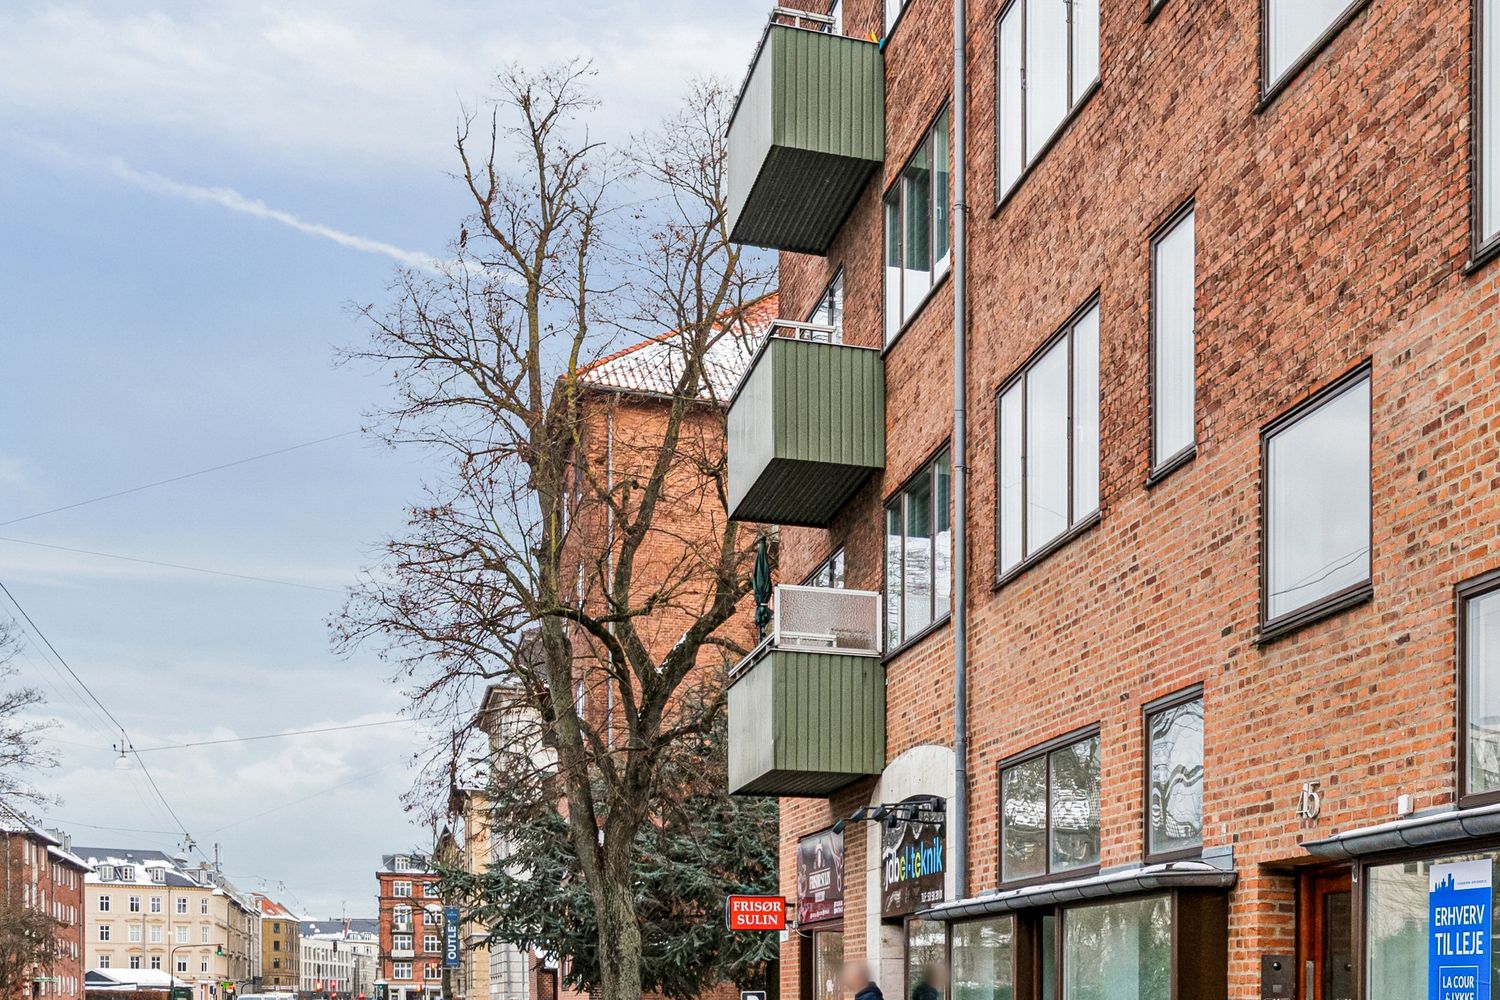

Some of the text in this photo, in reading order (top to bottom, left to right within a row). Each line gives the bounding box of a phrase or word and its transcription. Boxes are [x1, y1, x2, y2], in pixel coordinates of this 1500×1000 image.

[733, 901, 782, 912] FRISØR
[737, 914, 778, 925] SULIN
[1435, 904, 1485, 926] ERHVERV
[1435, 931, 1484, 955] TIL LEJE
[1442, 976, 1475, 989] LA COUR
